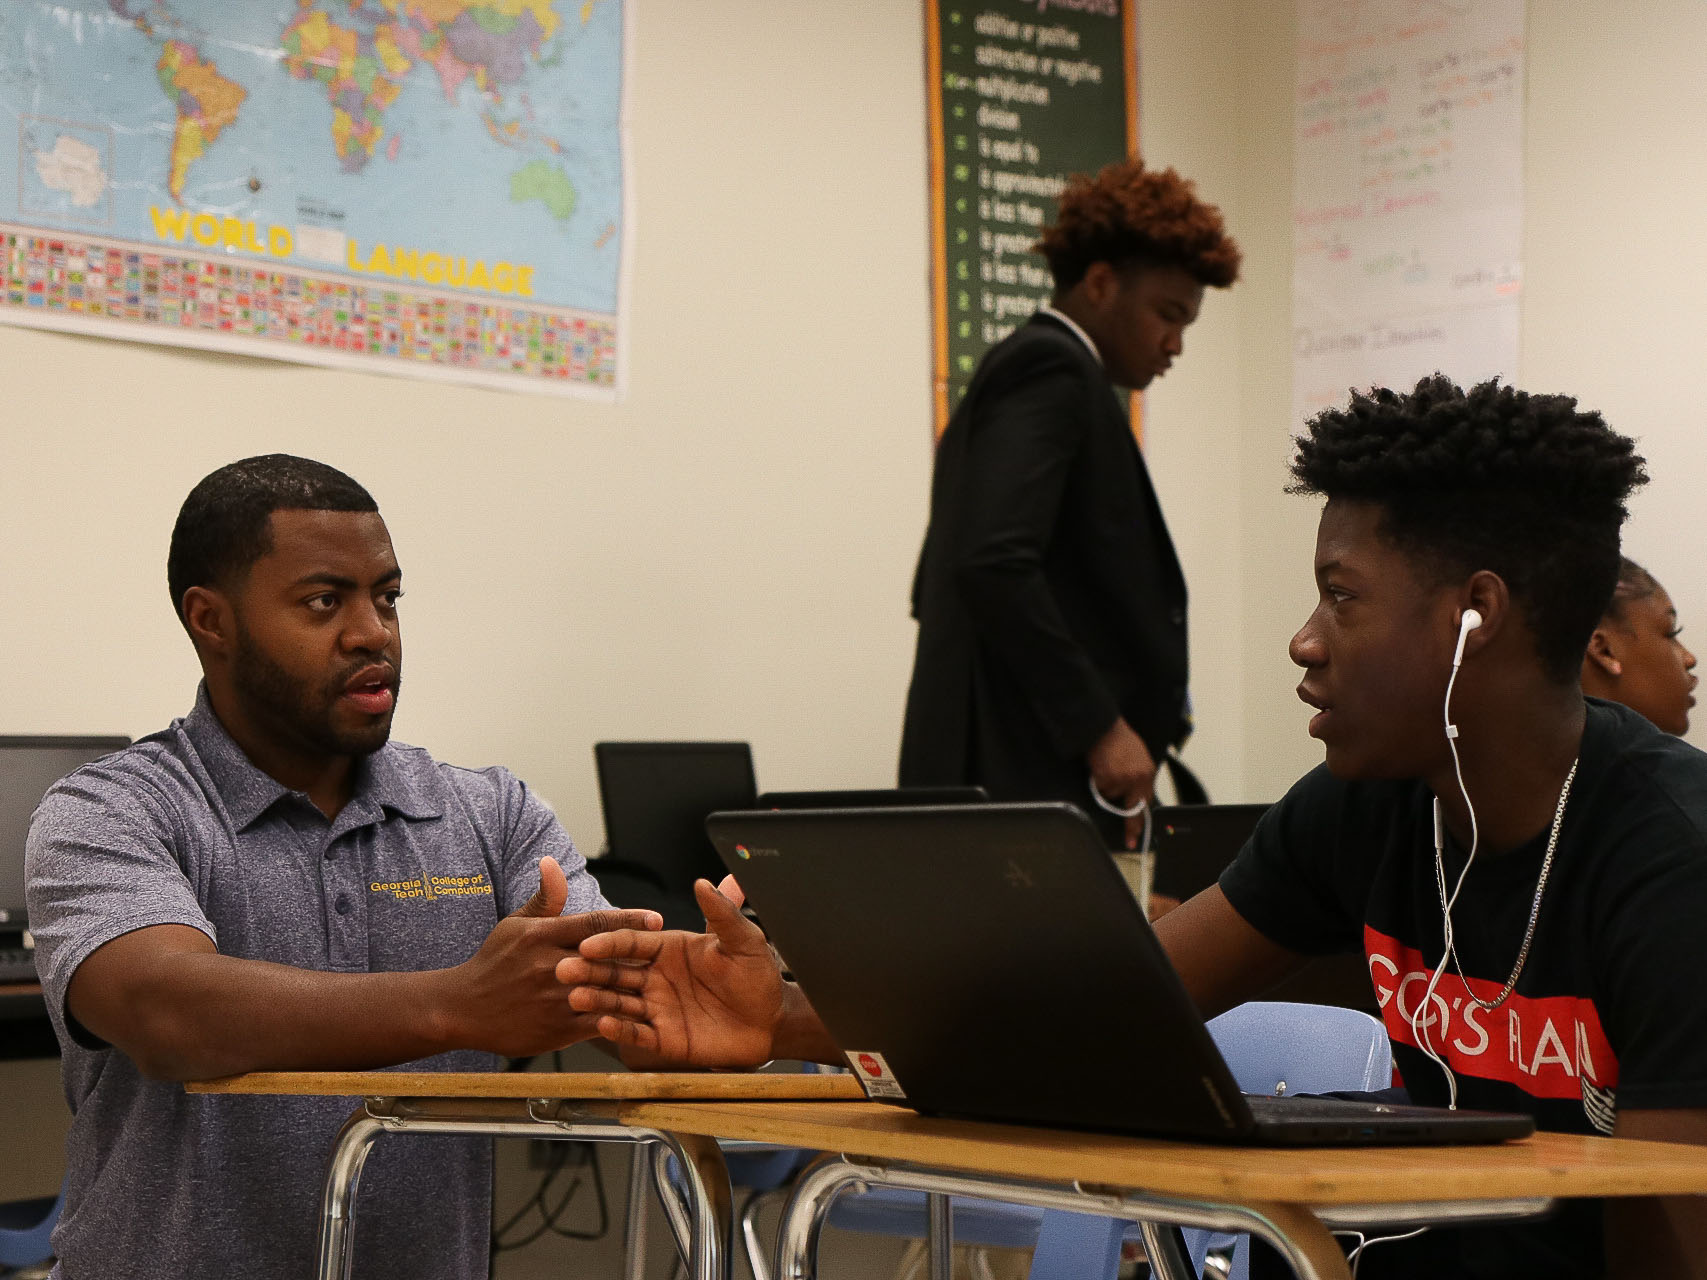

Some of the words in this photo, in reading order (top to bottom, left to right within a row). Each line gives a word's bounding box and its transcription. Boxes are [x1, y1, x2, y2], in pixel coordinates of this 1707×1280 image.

[150, 205, 294, 257] WORLD
[347, 239, 535, 297] LANGUAGE
[370, 880, 421, 891] Georgia
[431, 876, 469, 887] College
[471, 874, 483, 884] of
[392, 888, 424, 899] Tech
[434, 884, 492, 895] Computing
[1509, 1008, 1597, 1082] PLAN
